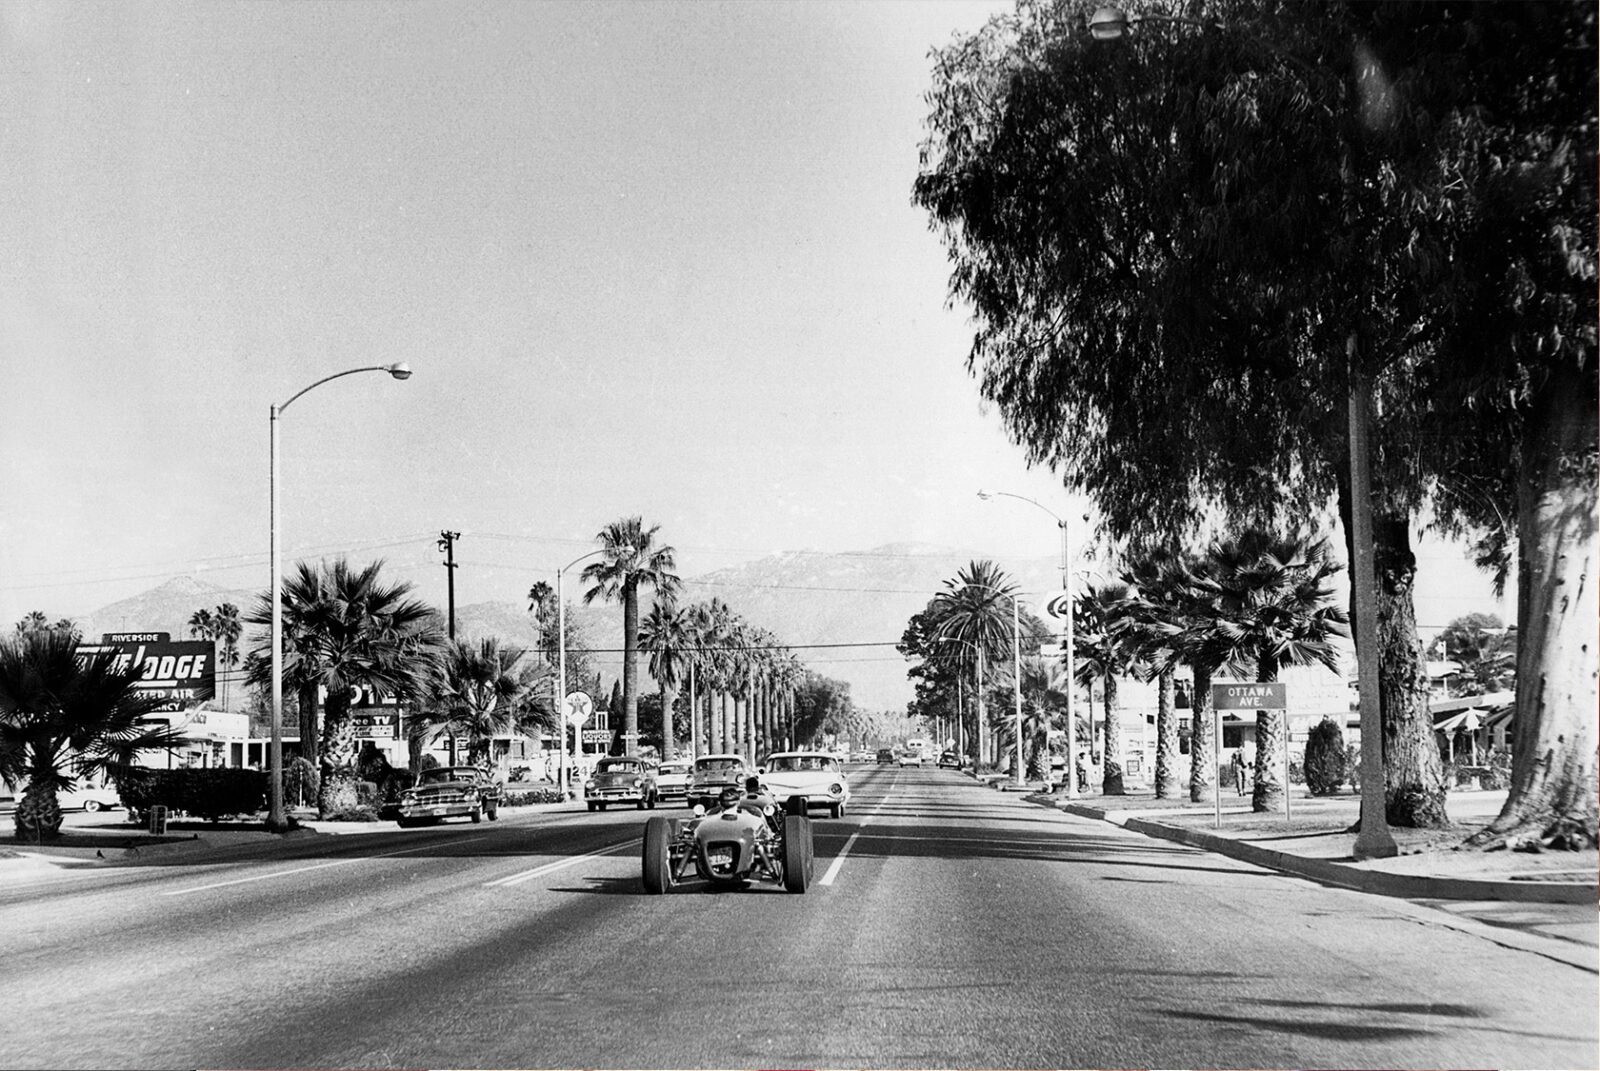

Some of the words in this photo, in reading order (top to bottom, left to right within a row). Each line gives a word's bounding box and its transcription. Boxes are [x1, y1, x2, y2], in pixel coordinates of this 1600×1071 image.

[112, 634, 159, 642] RIVERSIDE
[170, 688, 194, 699] AIR
[1228, 687, 1274, 697] OTTAWA
[1239, 696, 1264, 707] AVE.
[373, 715, 390, 725] TV
[572, 766, 588, 777] 24
